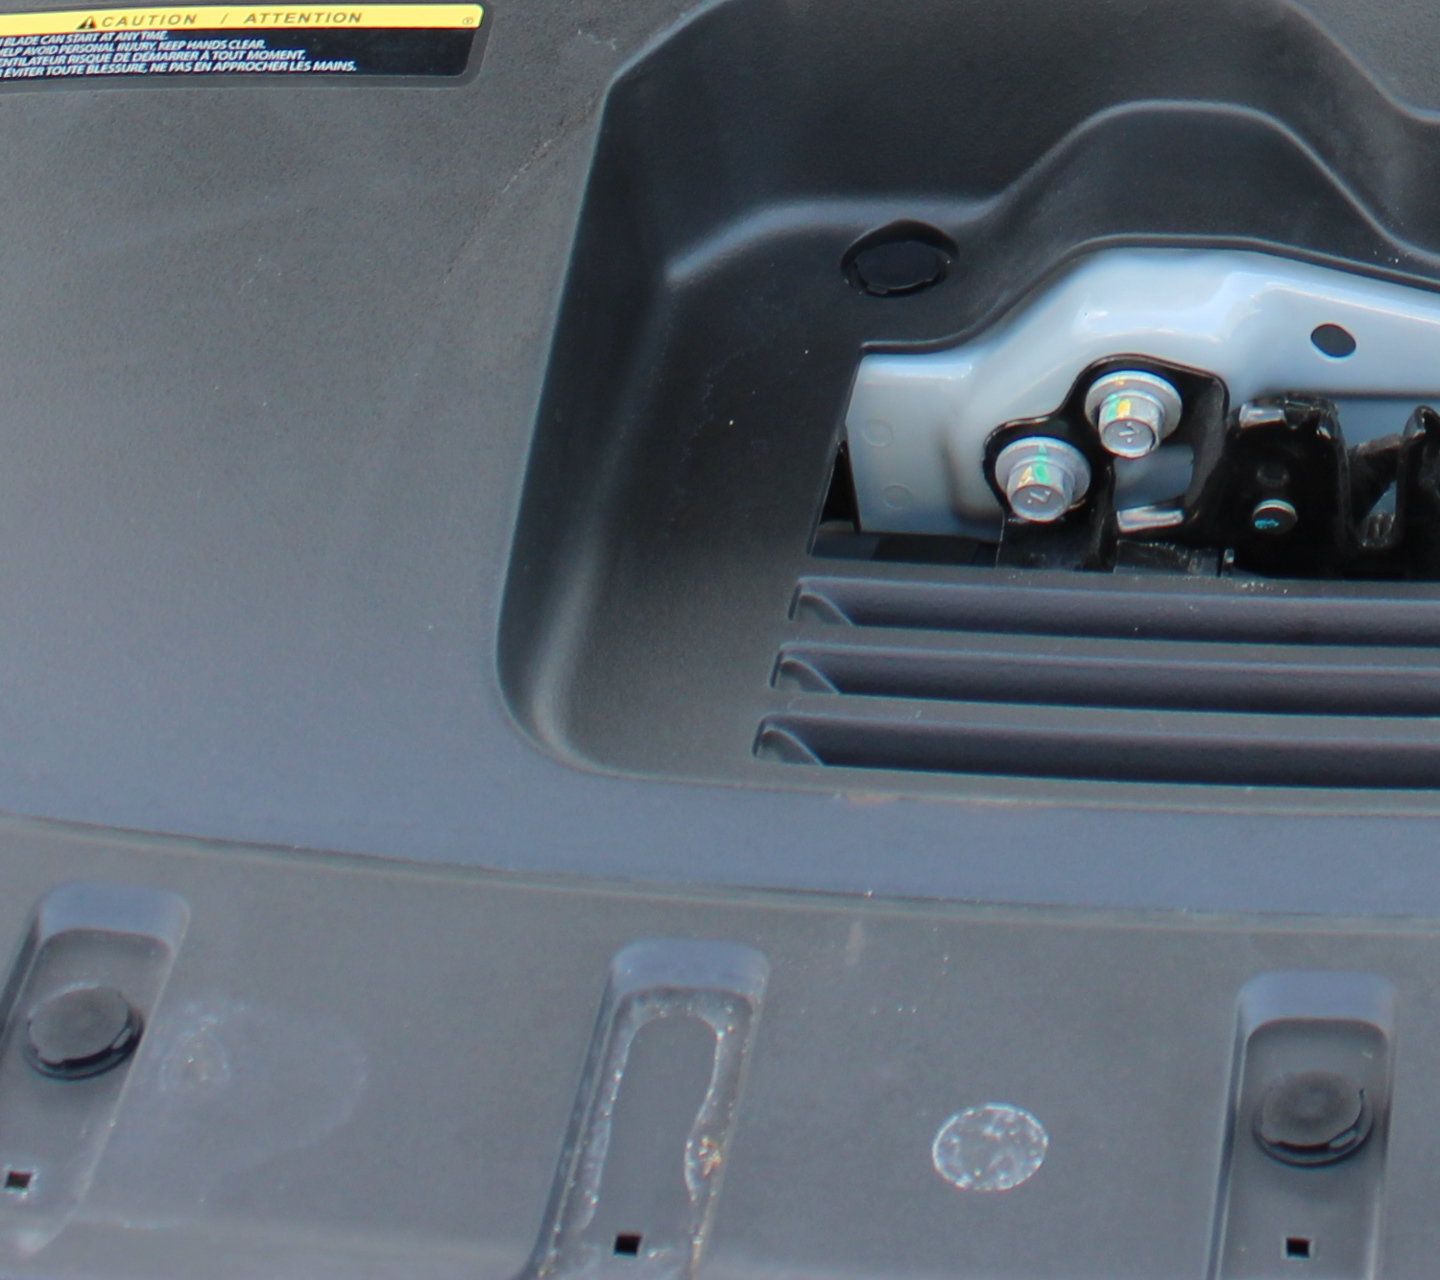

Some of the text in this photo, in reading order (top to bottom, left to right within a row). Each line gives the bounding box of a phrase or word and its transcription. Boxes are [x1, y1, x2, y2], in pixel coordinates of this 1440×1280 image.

[101, 14, 197, 28] CAUTION
[243, 11, 363, 25] ATTENTION
[3, 36, 40, 47] BLADE
[40, 34, 67, 45] CAN
[66, 33, 100, 44] START
[99, 32, 116, 42] AT
[114, 31, 140, 42] ANY
[140, 29, 168, 40] TIME.
[23, 44, 58, 56] AVOID
[58, 42, 116, 54] PERSONAL
[158, 40, 187, 50] KEEP
[186, 39, 227, 50] HANDS
[228, 39, 266, 49] CLEAR.
[67, 53, 112, 65] RISQUE
[112, 52, 131, 62] DE
[212, 50, 247, 61] TOUT
[246, 49, 306, 60] MOMENT.
[46, 65, 85, 76] TOUTE
[149, 62, 168, 73] NE
[168, 62, 192, 73] PAS
[192, 61, 211, 72] EN
[211, 61, 289, 72] APPROCHER
[289, 61, 311, 71] LES
[311, 60, 357, 71] MAINS.
